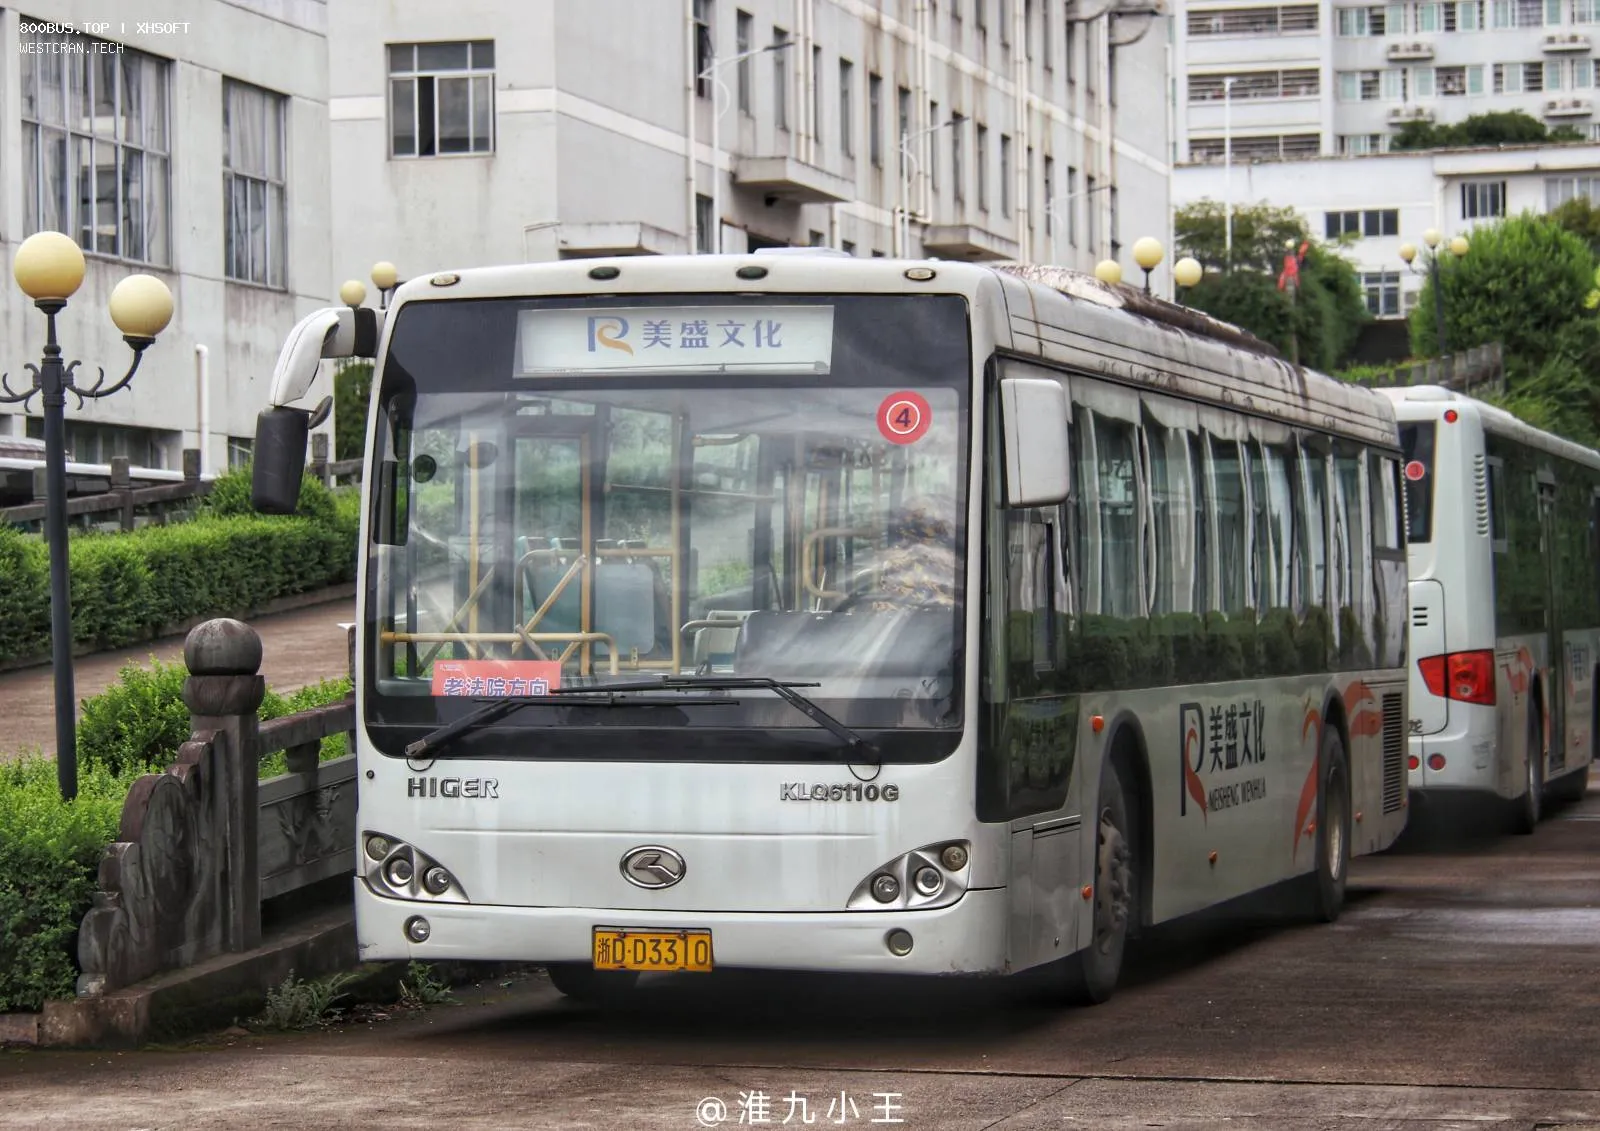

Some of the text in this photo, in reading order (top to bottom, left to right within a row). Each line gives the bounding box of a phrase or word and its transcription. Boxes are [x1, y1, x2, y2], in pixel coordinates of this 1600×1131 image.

[642, 319, 783, 350] 美盛文化
[895, 408, 912, 428] 4
[443, 677, 550, 696] 老法院方向
[1208, 700, 1266, 774] 美盛文化
[407, 777, 499, 799] HIGER
[780, 782, 900, 802] KLQ6110G
